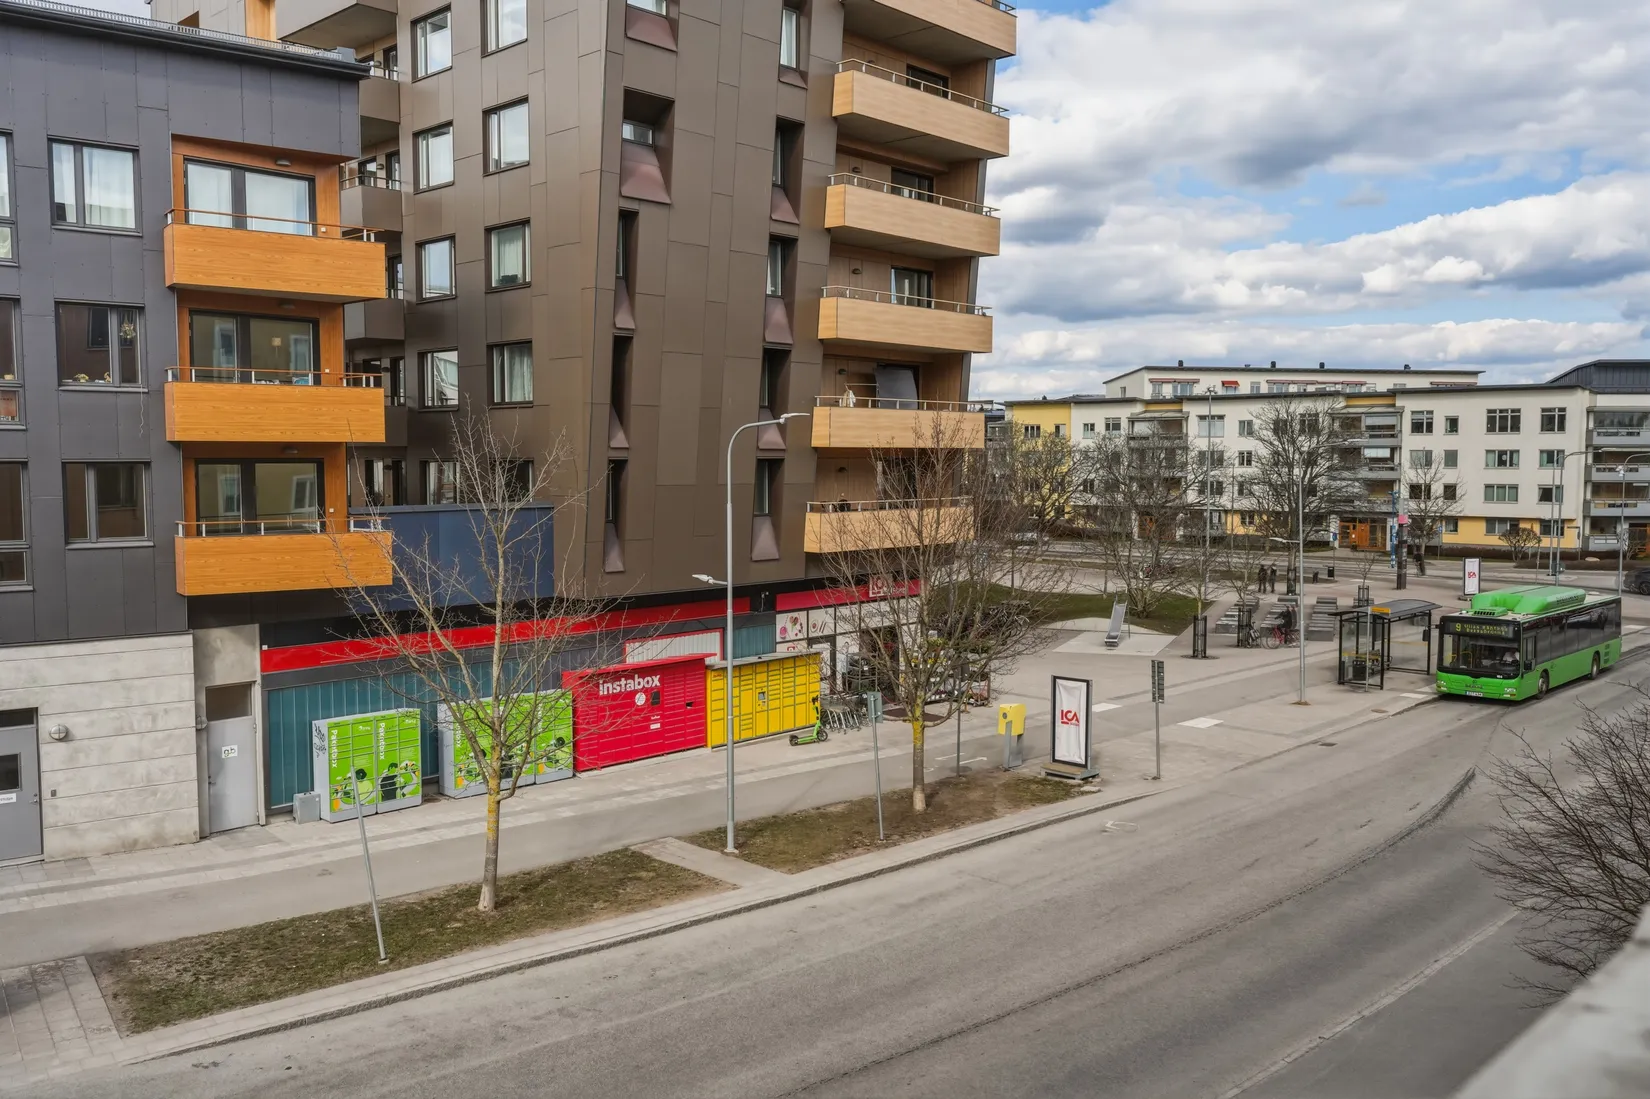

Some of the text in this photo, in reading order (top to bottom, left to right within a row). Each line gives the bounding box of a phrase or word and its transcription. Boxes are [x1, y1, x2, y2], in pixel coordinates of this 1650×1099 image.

[1455, 622, 1462, 632] 9
[599, 674, 661, 696] instabox
[1060, 709, 1080, 724] ICA
